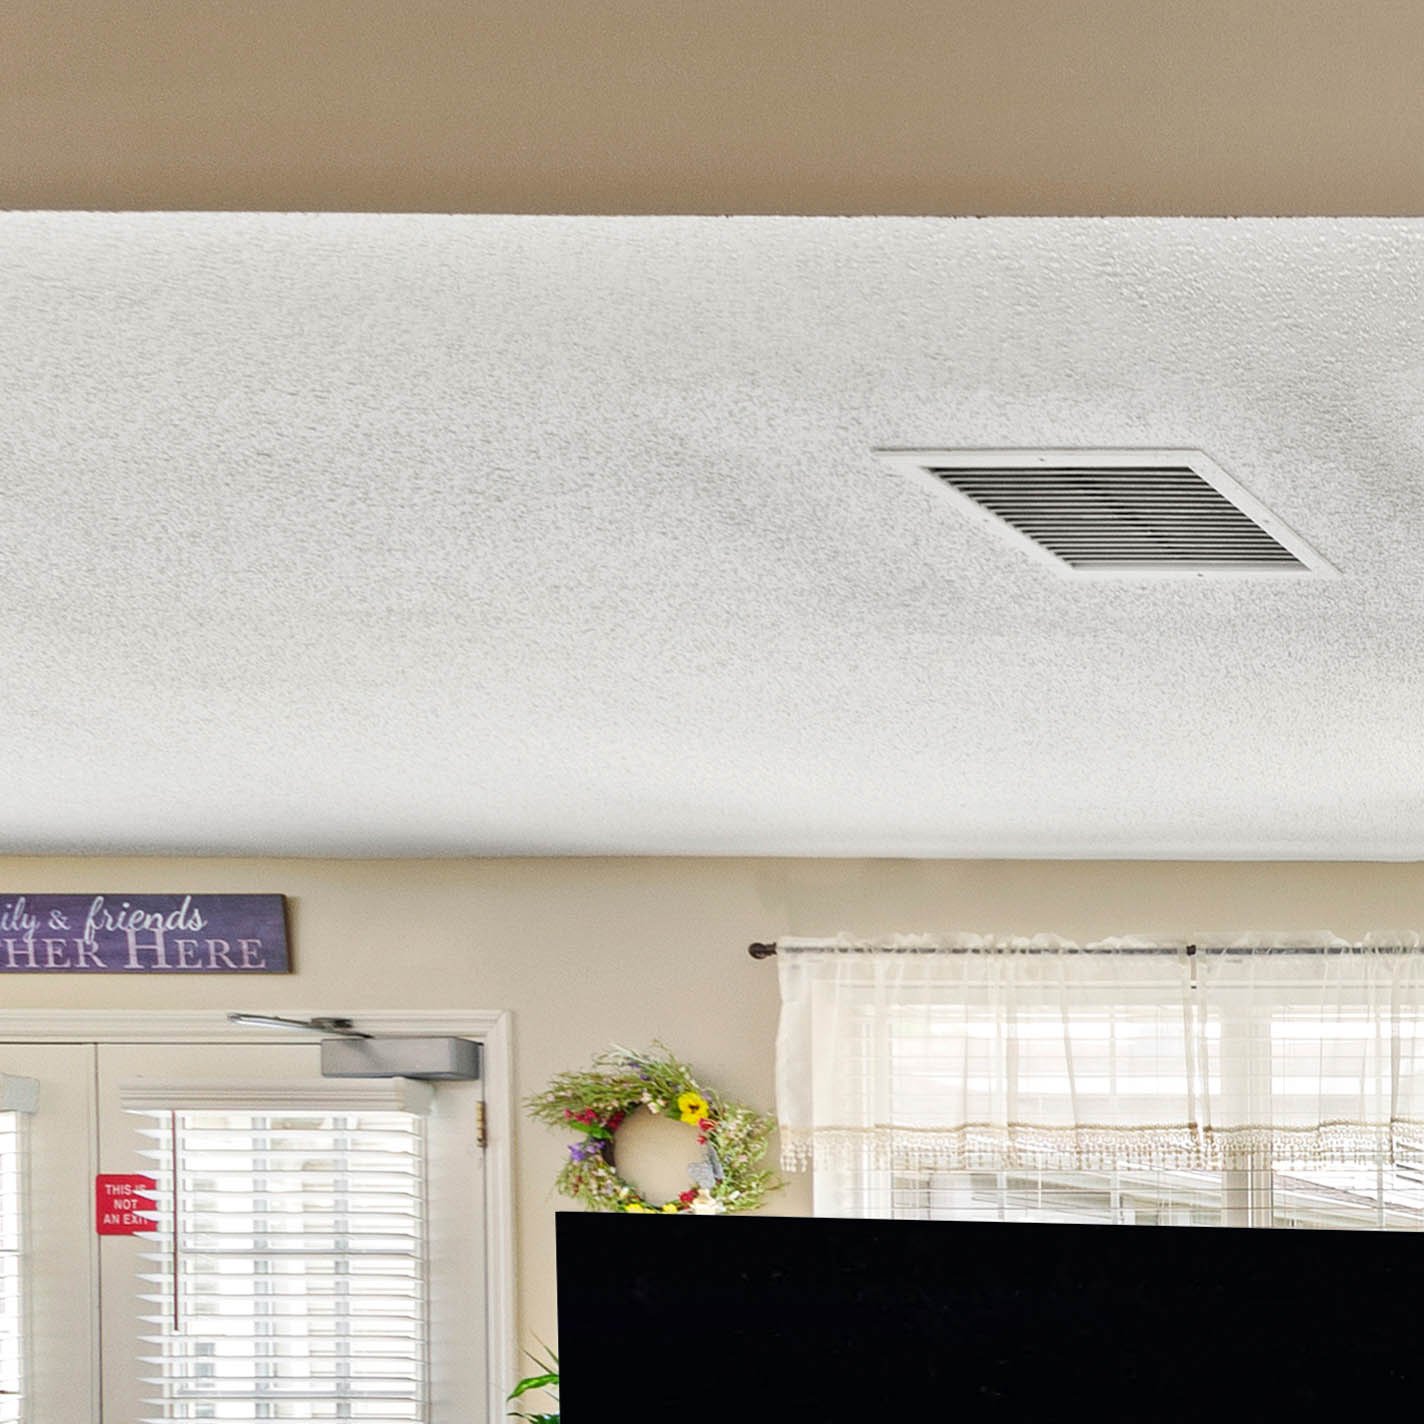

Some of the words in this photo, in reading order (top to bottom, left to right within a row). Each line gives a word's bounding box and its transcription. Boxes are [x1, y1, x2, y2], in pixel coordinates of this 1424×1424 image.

[48, 909, 72, 930] &
[84, 895, 208, 944] friends
[123, 927, 266, 969] HERE
[104, 1184, 132, 1196] THIS
[113, 1199, 138, 1210] NOT
[103, 1213, 120, 1225] AN
